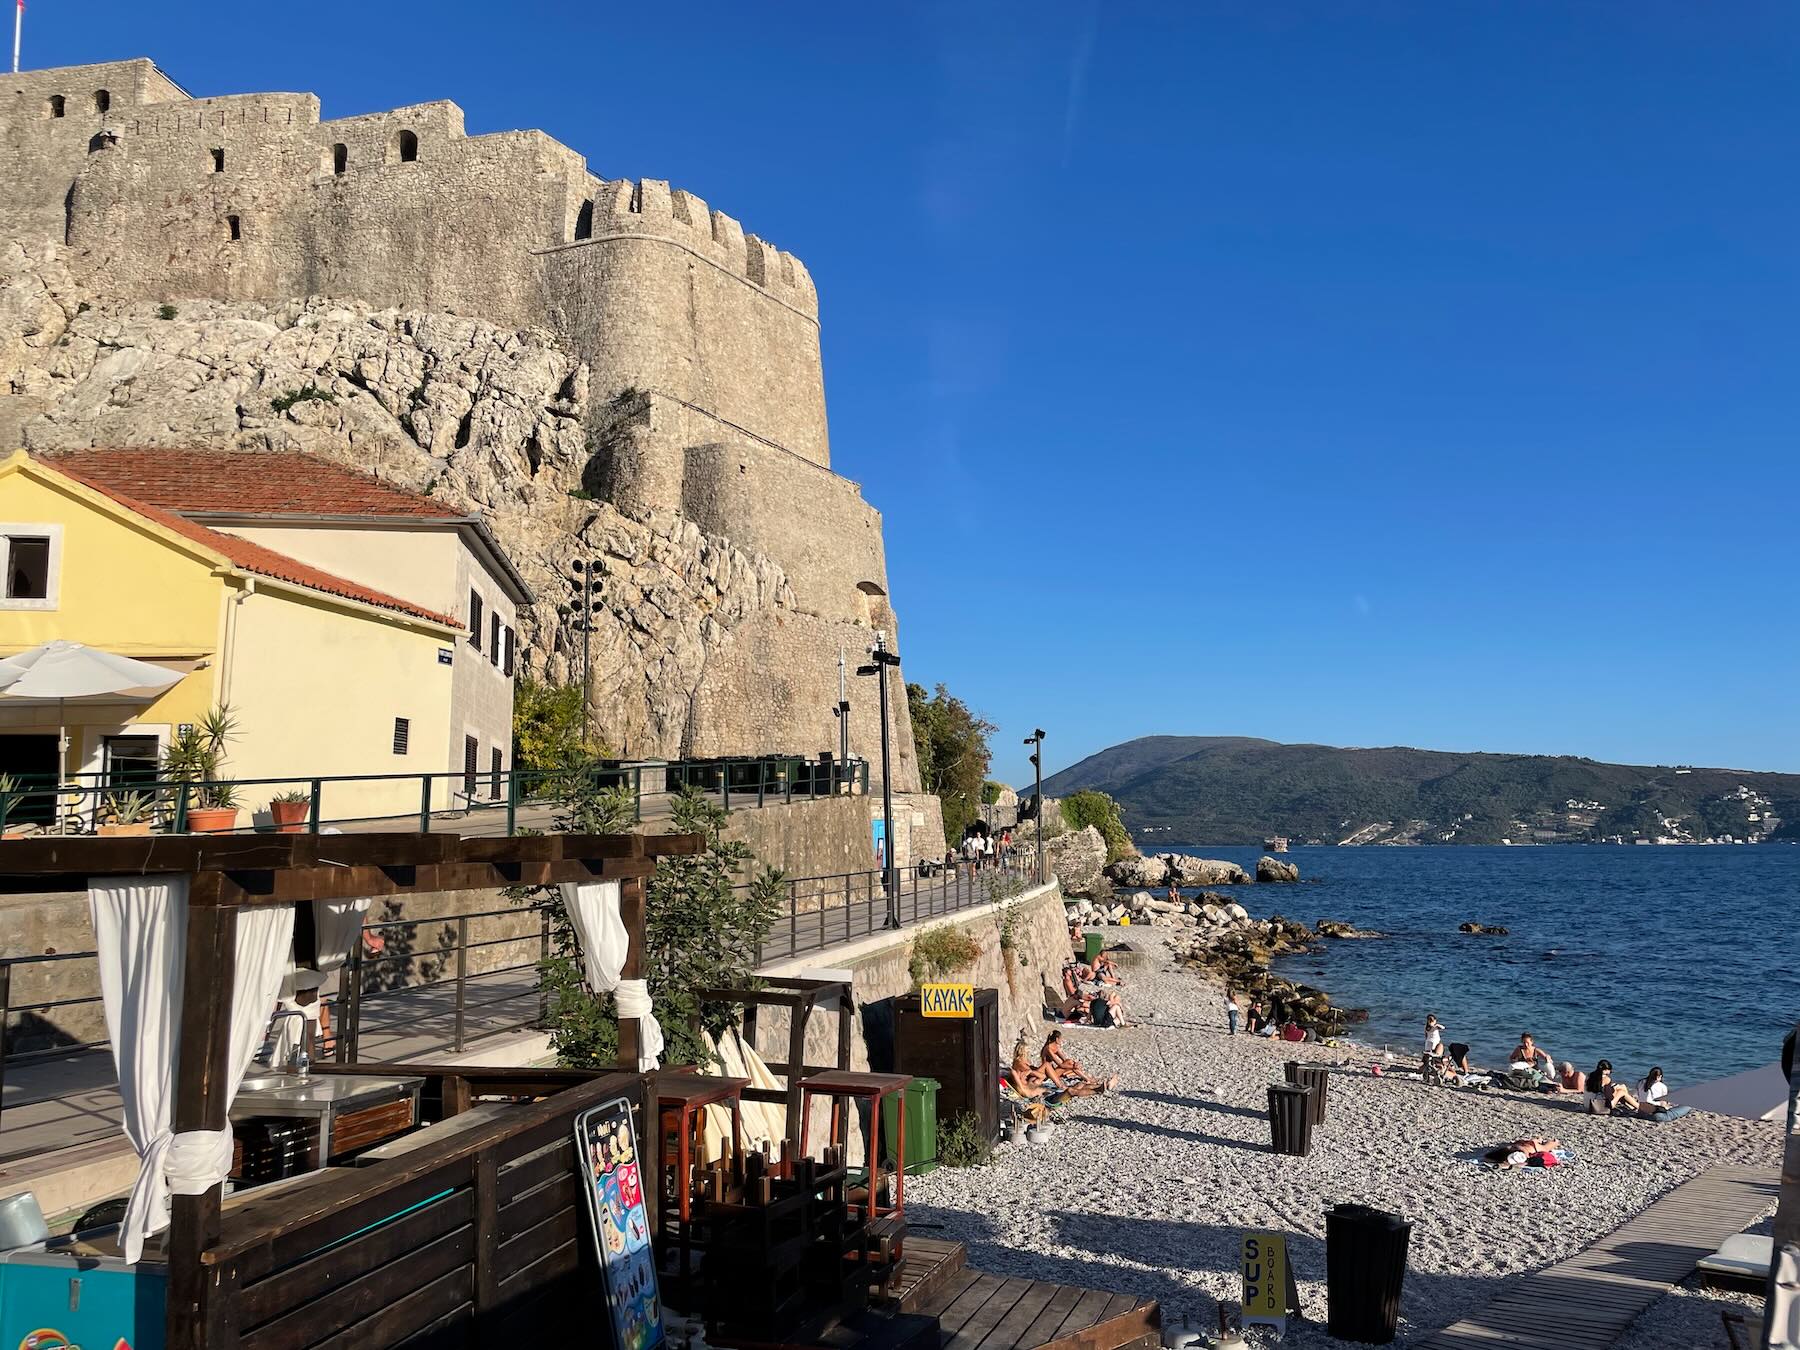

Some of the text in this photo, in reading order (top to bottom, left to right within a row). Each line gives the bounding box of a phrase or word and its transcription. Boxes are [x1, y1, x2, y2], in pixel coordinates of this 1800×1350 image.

[923, 988, 969, 1011] KAYAK
[1245, 1238, 1260, 1306] SUP
[1267, 1246, 1276, 1309] BOARD
